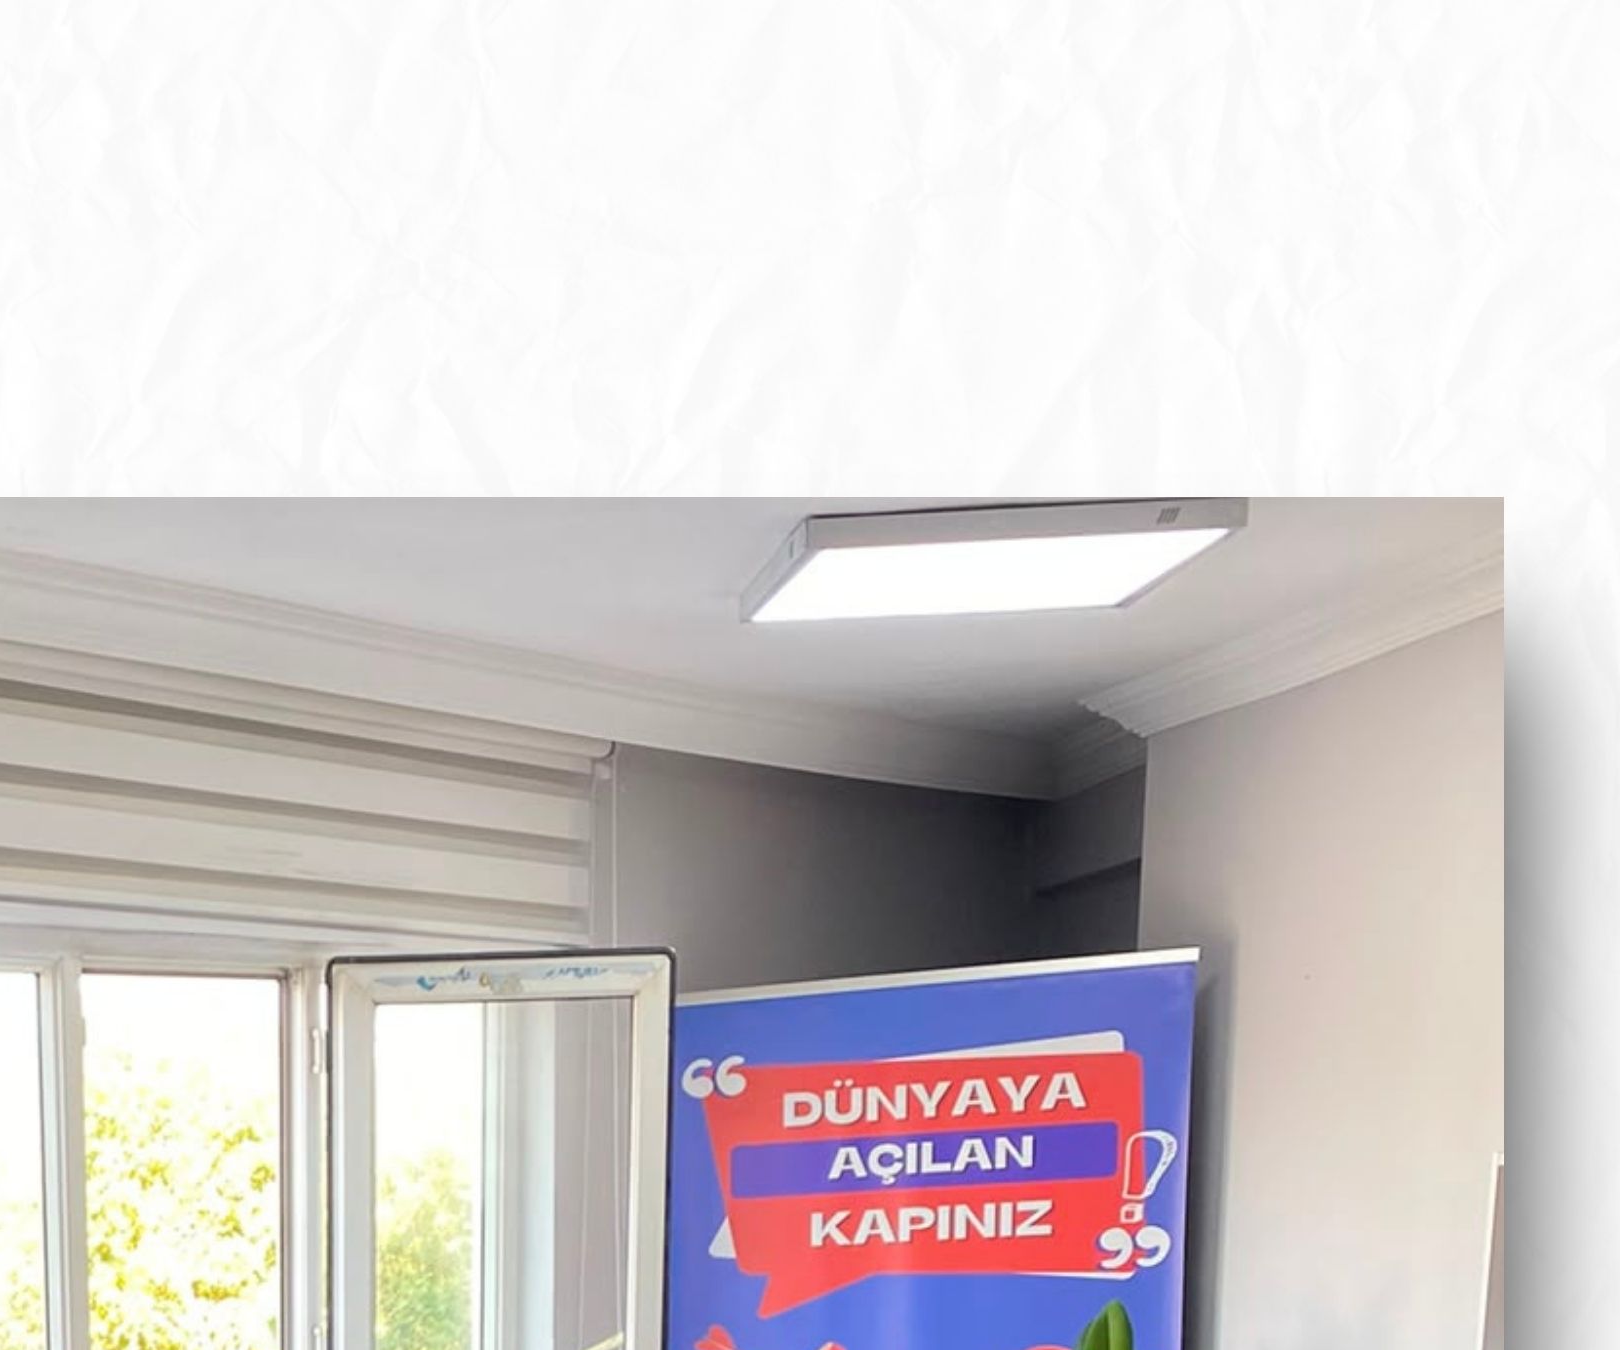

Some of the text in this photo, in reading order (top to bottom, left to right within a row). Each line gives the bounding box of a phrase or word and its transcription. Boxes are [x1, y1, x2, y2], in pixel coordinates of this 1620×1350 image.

[782, 1072, 1087, 1129] DÜNYAYA
[828, 1135, 1035, 1185] AÇILAN
[810, 1200, 1053, 1248] KAPINIZ
